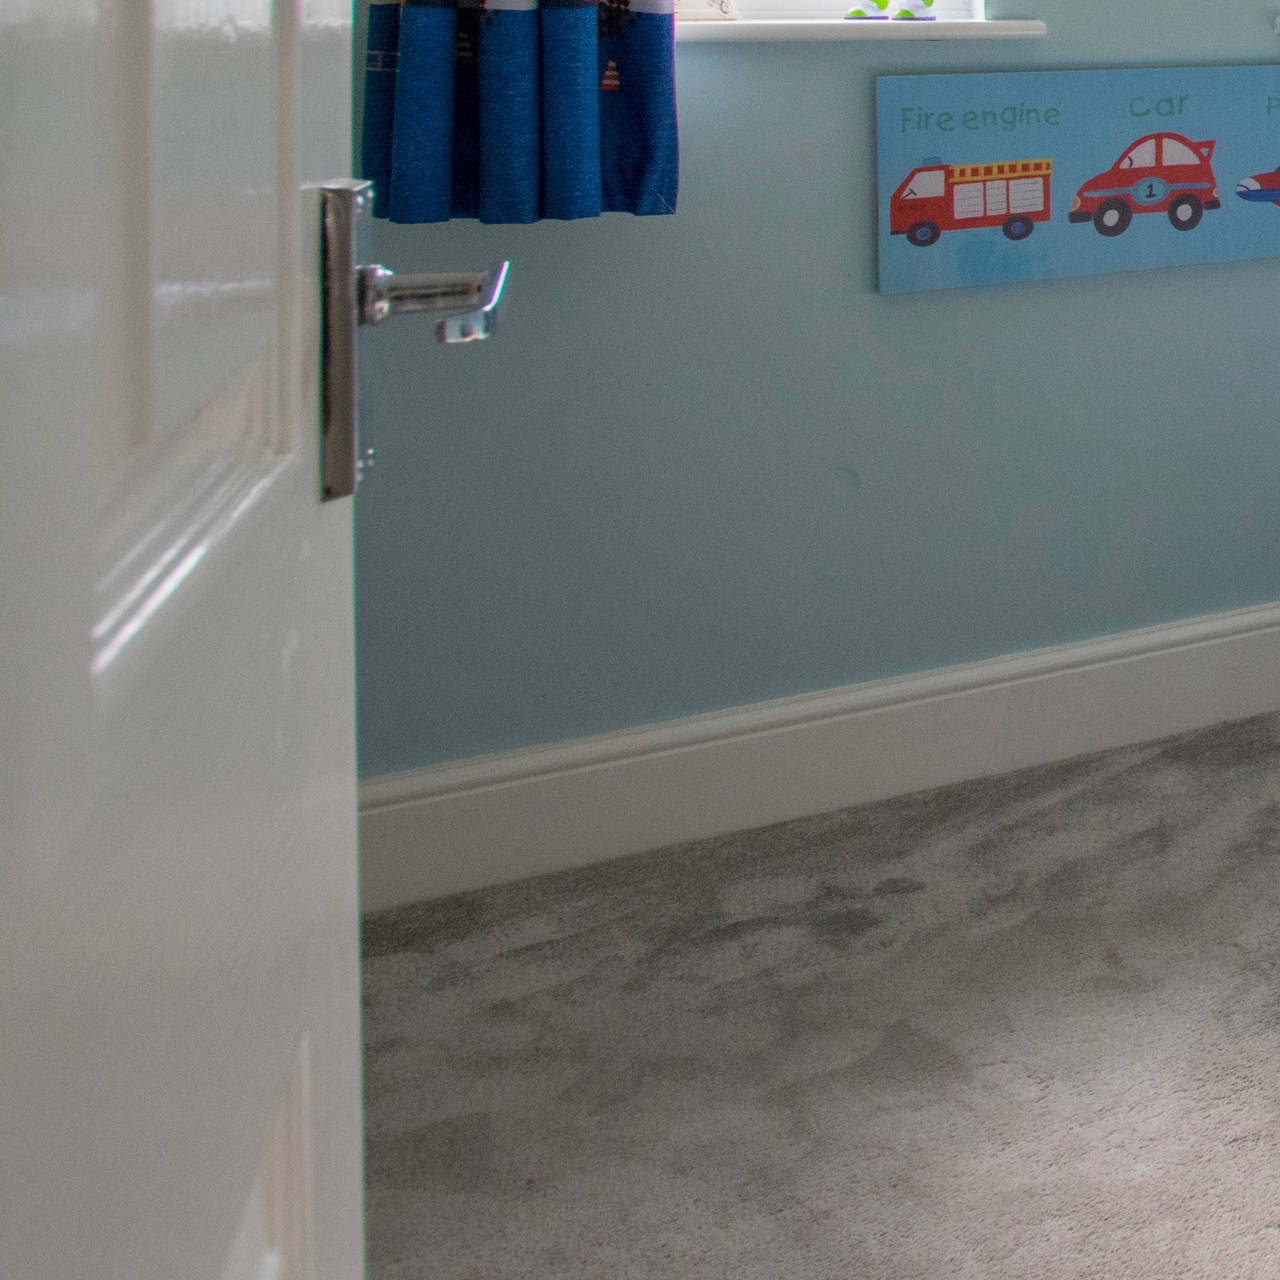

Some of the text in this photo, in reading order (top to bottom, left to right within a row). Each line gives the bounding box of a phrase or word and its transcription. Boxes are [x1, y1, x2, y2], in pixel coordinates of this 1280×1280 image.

[901, 102, 1061, 133] Fire engine
[1129, 93, 1189, 118] Car
[1145, 182, 1157, 199] 1
